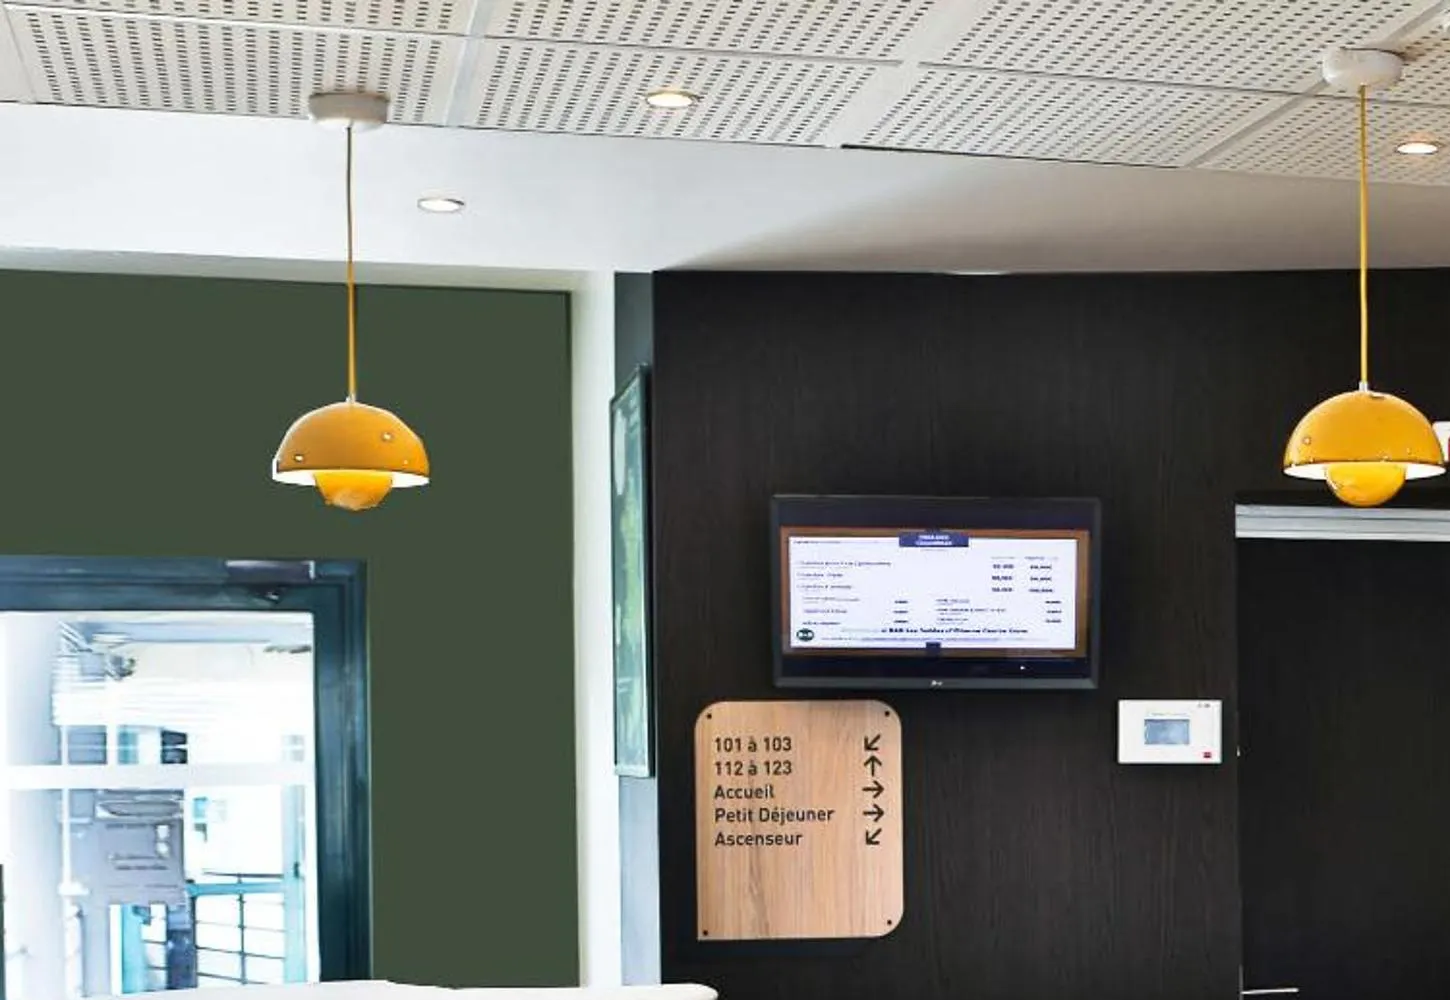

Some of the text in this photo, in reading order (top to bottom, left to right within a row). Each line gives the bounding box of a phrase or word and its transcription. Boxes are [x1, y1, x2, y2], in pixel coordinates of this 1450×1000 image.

[714, 736, 792, 752] 101 à 103
[714, 759, 793, 776] 112 à 123
[714, 784, 775, 799] Accueil
[714, 806, 835, 825] Petit Déjeuner
[714, 832, 803, 847] Ascenseur
